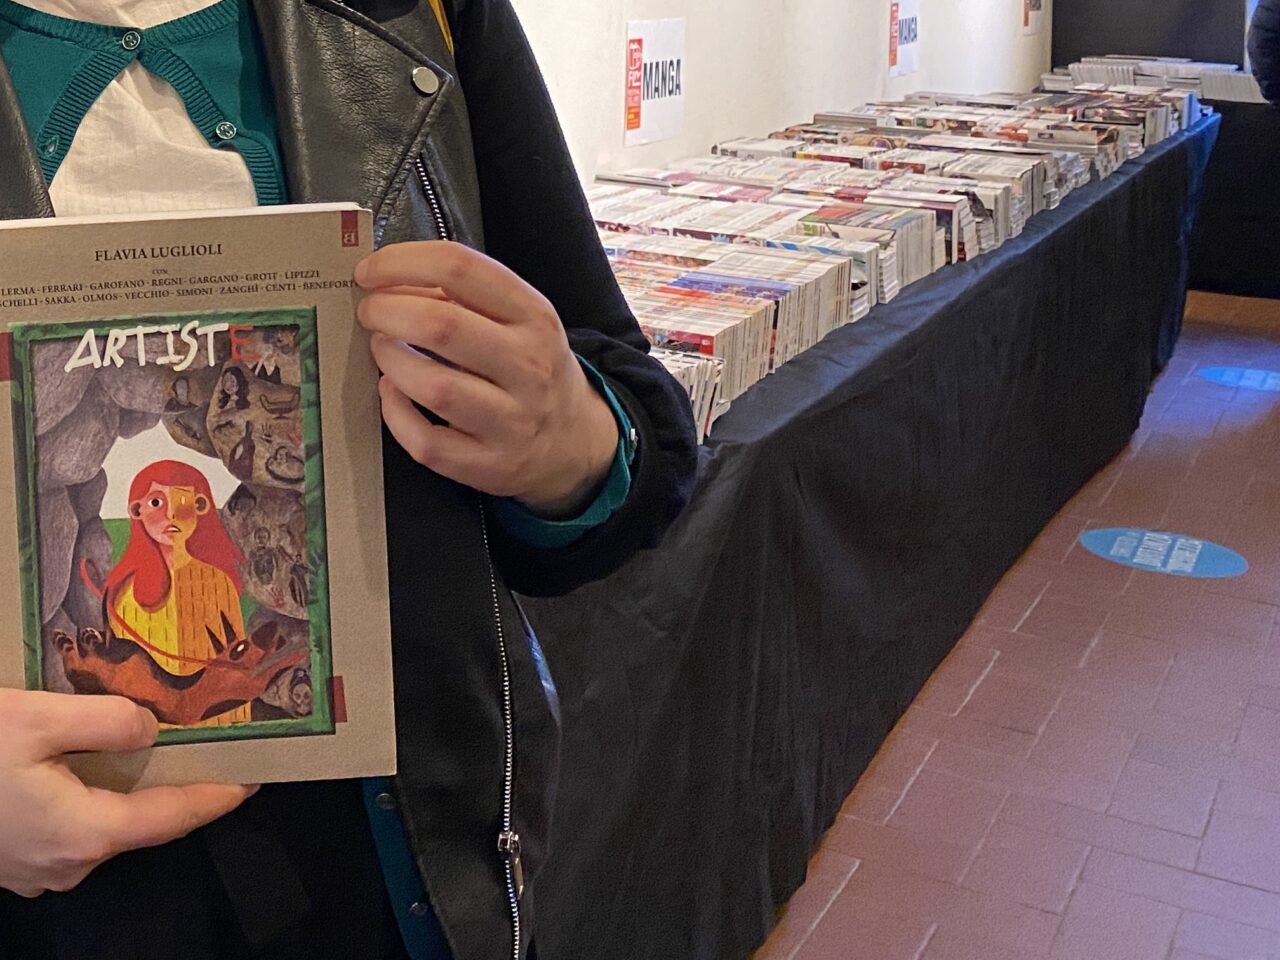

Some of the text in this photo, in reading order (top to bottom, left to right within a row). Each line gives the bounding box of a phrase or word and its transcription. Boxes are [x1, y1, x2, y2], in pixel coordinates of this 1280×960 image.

[642, 58, 682, 101] MANGA
[95, 243, 223, 262] FLAVIA LUGLIOLI
[1, 287, 36, 297] LERMA
[42, 283, 83, 294] FERRARI
[90, 279, 145, 291] GAROFANO
[151, 277, 183, 287] REGNI
[189, 274, 239, 285] GARGANO
[284, 269, 320, 280] LIPIZZI
[45, 295, 77, 306] SAKKA
[82, 293, 118, 303] OLMOS
[124, 289, 170, 300] VECCHIO
[176, 287, 214, 297] SIMONI
[265, 282, 297, 292] CENTI
[64, 320, 262, 373] ARTISTE
